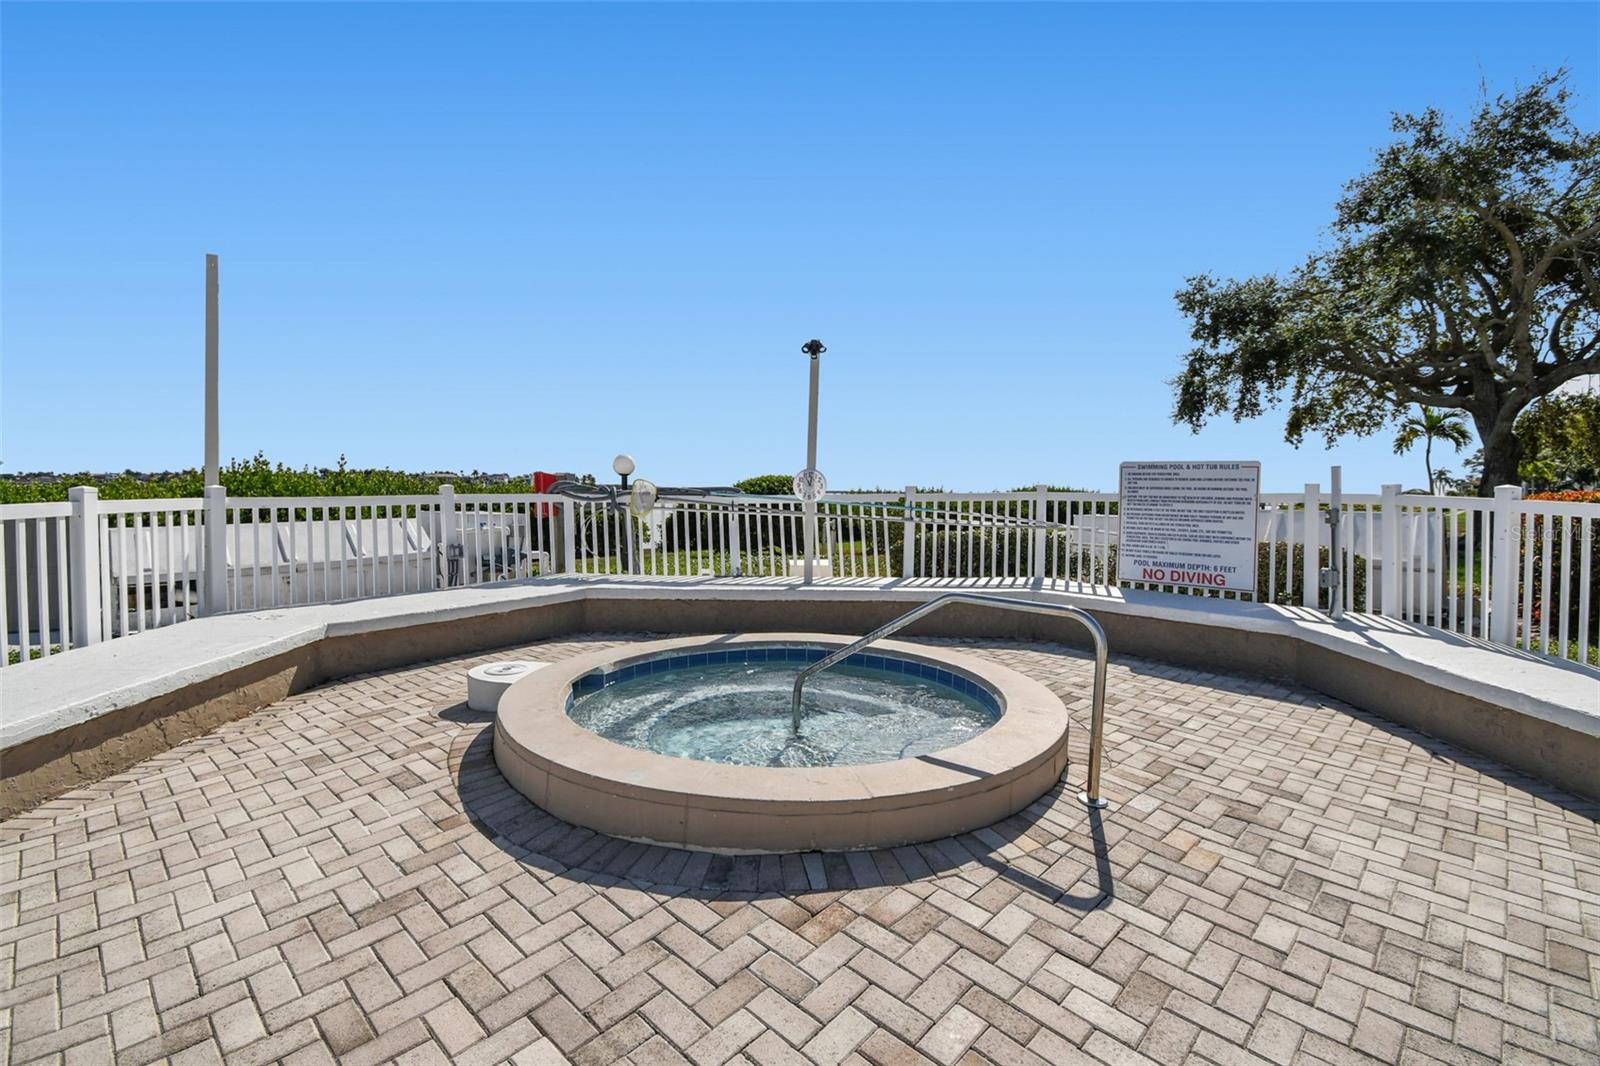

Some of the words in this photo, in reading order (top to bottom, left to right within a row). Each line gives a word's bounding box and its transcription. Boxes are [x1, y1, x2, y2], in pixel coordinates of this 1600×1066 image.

[1137, 463, 1168, 471] SWIMMING
[1169, 463, 1184, 471] POOL
[1184, 463, 1191, 471] &
[1192, 463, 1205, 471] HOT
[1206, 463, 1218, 471] TUB
[1219, 463, 1240, 471] RULES
[1133, 559, 1151, 567] POOL
[1152, 561, 1186, 569] MAXIMUM
[1187, 563, 1212, 572] DEPTH:
[1219, 566, 1237, 574] FEET
[1142, 568, 1166, 581] NO
[1170, 570, 1226, 586] DIVING
